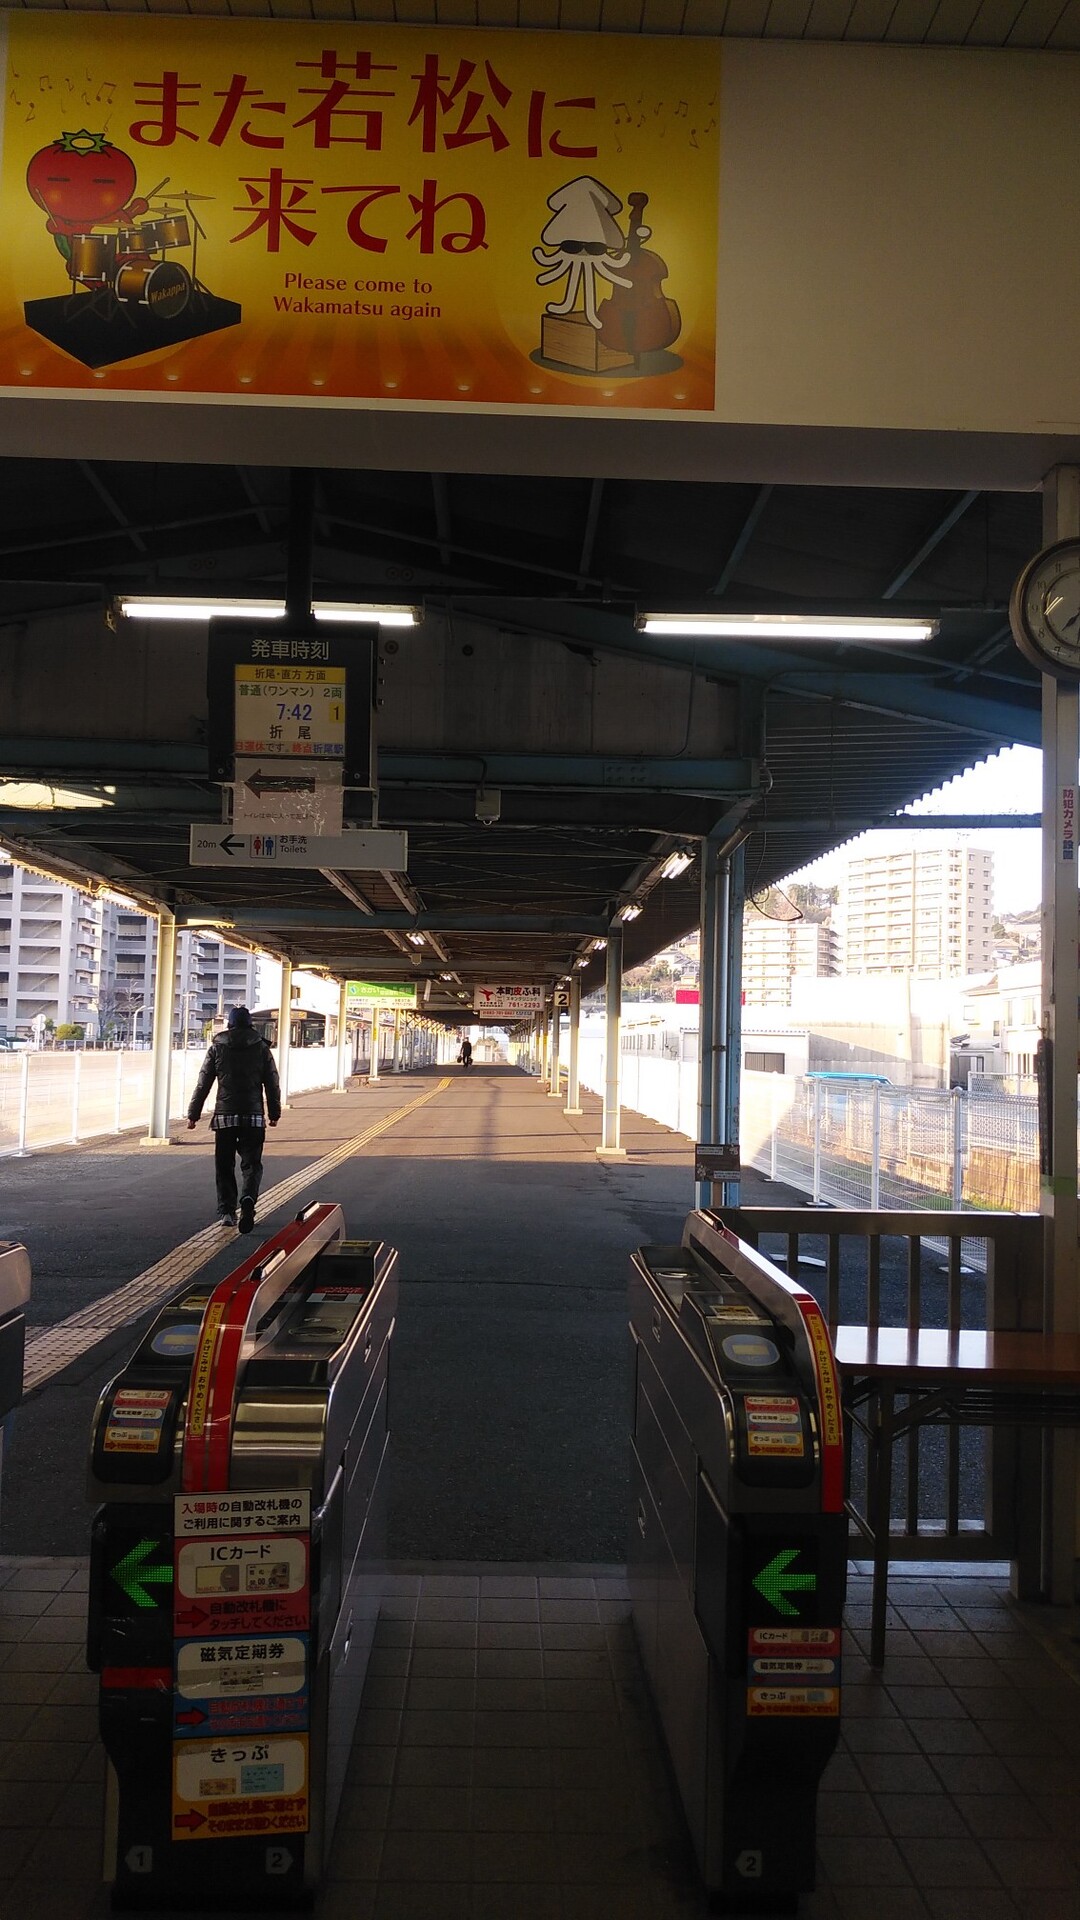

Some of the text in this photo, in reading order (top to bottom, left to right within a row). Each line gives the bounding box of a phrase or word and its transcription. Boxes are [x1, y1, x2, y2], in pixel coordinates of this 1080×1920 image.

[128, 50, 599, 158] また若松に
[229, 168, 490, 254] 来てね
[285, 273, 433, 294] Please come to
[151, 282, 187, 304] Wakappa
[273, 296, 441, 321] Wakamatsu again
[251, 639, 331, 660] 発車時刻
[255, 668, 326, 681] 折尾・直方 方面
[276, 703, 340, 721] 7:42 1
[1063, 789, 1074, 860] 防犯カメラ設置
[197, 839, 217, 848] 20m
[280, 845, 308, 854] Toilets
[496, 986, 541, 997] 本町皮ふ科
[557, 993, 568, 1006] 2
[508, 1001, 541, 1009] 761-2293
[181, 1498, 303, 1515] 入場時の自動改札機の
[183, 1514, 301, 1530] ご利用に関するご案内
[210, 1545, 271, 1561] ICカード
[209, 1615, 307, 1632] タッチしてください
[200, 1642, 285, 1662] 磁気定期券
[210, 1744, 270, 1763] きっぷ
[137, 1853, 144, 1866] 1
[272, 1852, 283, 1867] 2
[746, 1856, 756, 1872] 2
